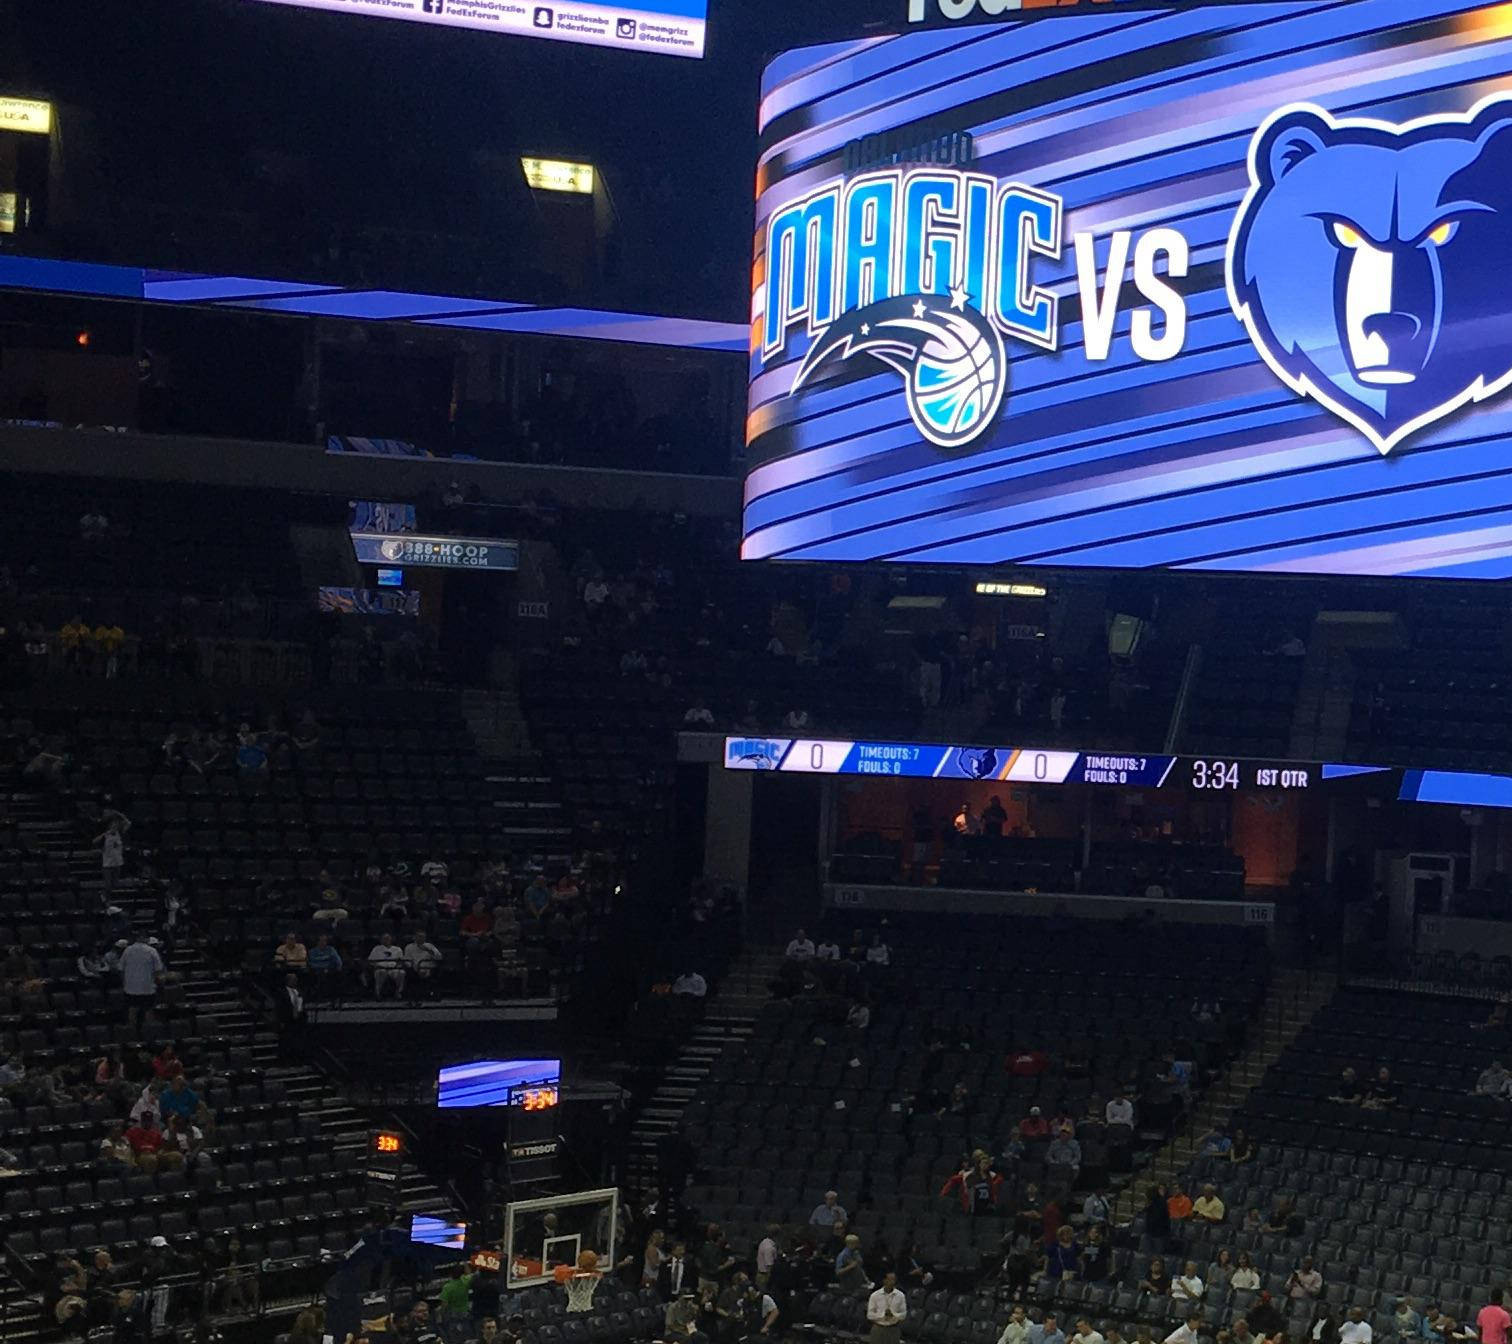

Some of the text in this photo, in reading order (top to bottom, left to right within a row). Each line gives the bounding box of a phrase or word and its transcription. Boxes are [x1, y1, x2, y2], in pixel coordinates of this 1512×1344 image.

[762, 168, 1189, 362] MAGIC VS
[811, 743, 823, 769] 0
[859, 745, 919, 761] TIMEOUTS: 7
[1086, 756, 1146, 771] TIMEOUTS: 7
[858, 760, 900, 773] FOULS: 0
[1035, 753, 1047, 779] 0
[1192, 760, 1308, 789] 3:34 1ST QTR
[1085, 770, 1127, 784] FOULS: 0
